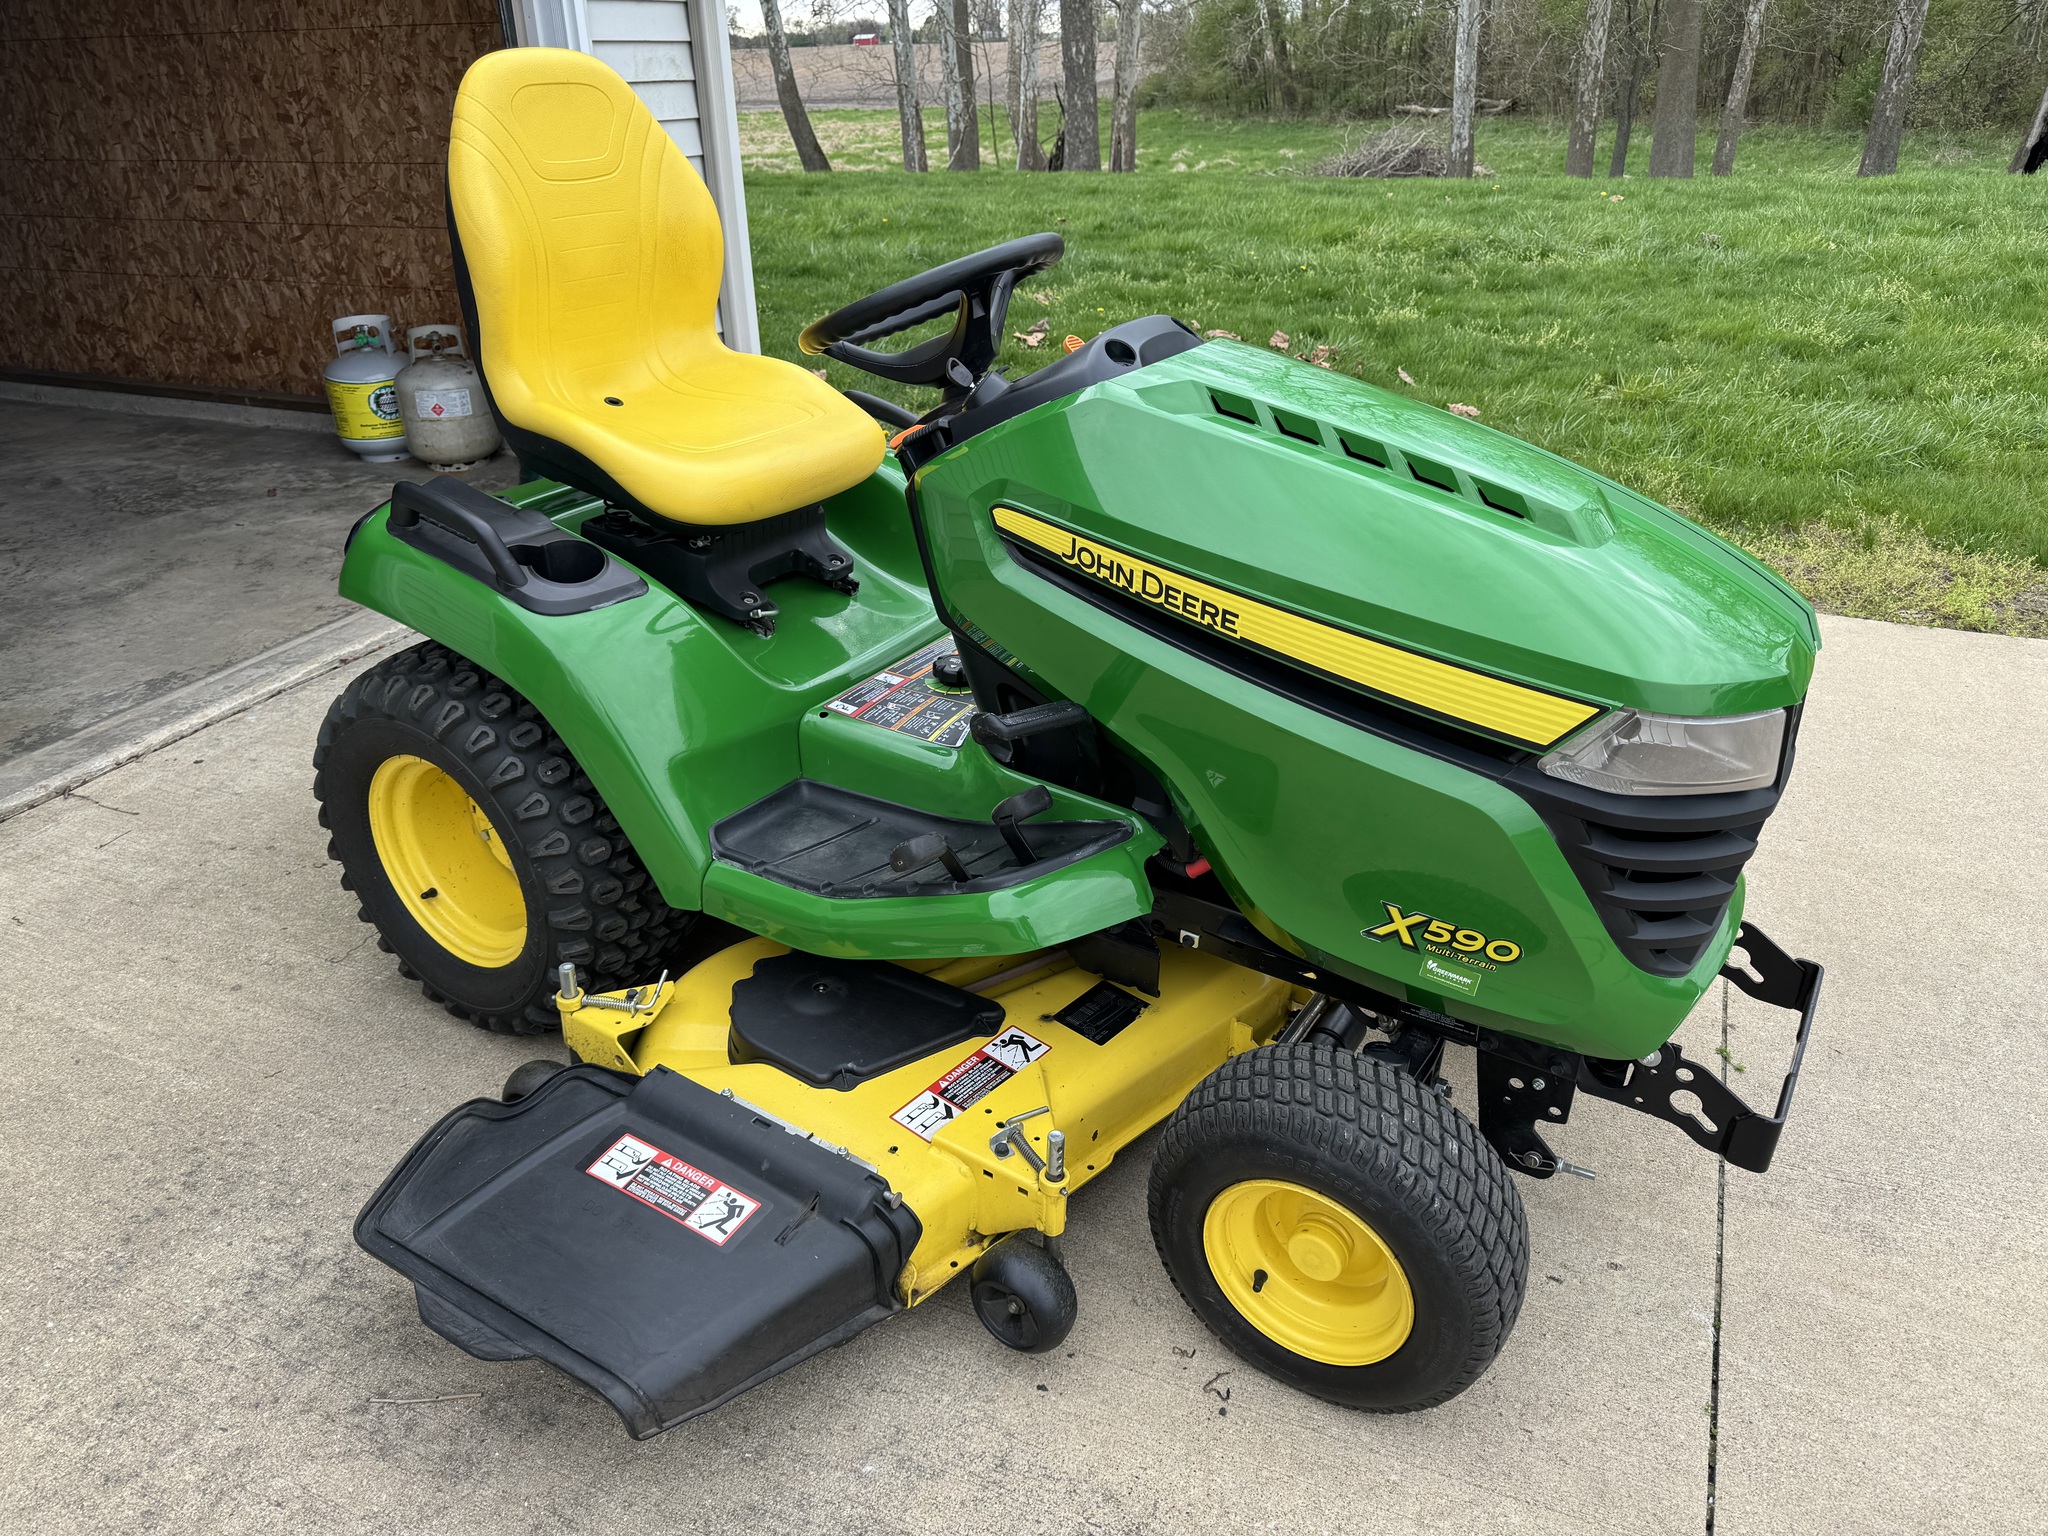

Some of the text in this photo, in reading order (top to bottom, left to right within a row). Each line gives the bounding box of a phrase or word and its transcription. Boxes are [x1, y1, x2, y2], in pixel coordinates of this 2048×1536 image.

[1061, 538, 1240, 635] JOHN DEERE
[1362, 902, 1523, 964] X590
[1425, 943, 1497, 972] Multi-Terrain
[945, 1055, 980, 1082] DANGER
[672, 1161, 716, 1188] DANGER
